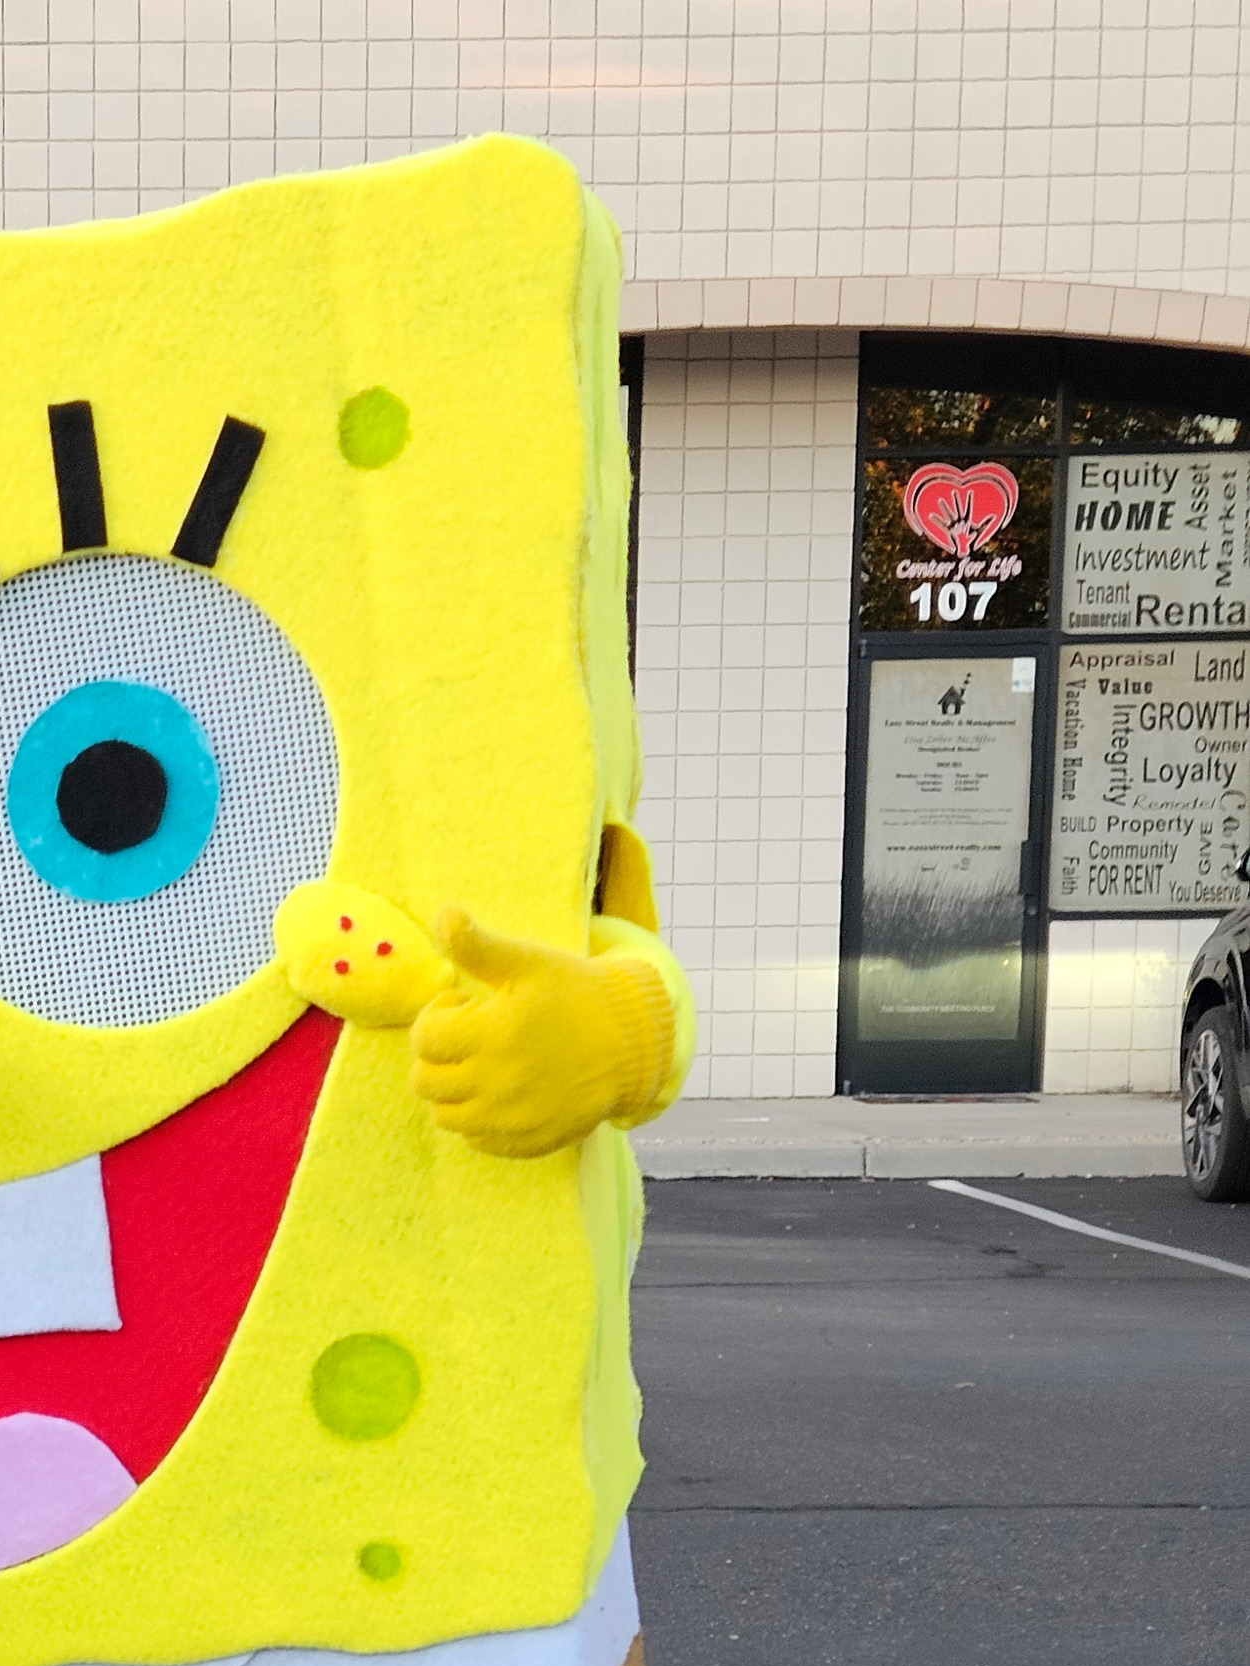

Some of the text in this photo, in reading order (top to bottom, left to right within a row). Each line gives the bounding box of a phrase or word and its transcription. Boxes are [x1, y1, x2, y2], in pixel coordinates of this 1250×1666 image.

[1081, 461, 1180, 494] Equity
[1185, 462, 1211, 531] Asset
[1075, 500, 1177, 531] HOME
[1216, 469, 1237, 588] Market
[952, 556, 986, 581] for
[1075, 540, 1210, 572] Investment
[910, 581, 998, 621] 107
[1076, 578, 1131, 605] Tenant
[1068, 610, 1131, 629] Commercial
[1069, 649, 1175, 671] Appraisal
[1194, 649, 1246, 683] Land
[1098, 678, 1153, 695] Value
[1139, 700, 1250, 731] GROWTH
[1062, 678, 1087, 801] Vacation Home
[1103, 703, 1138, 807] Integrity
[1195, 735, 1248, 753] Owner
[1143, 756, 1237, 789] Loyalty
[1060, 816, 1097, 833] BUILD
[1107, 815, 1194, 836] Property
[1088, 839, 1179, 864] Community
[1061, 856, 1080, 895] Faith
[1088, 864, 1164, 895] FOR RENT
[1169, 880, 1241, 903] You Deserve
